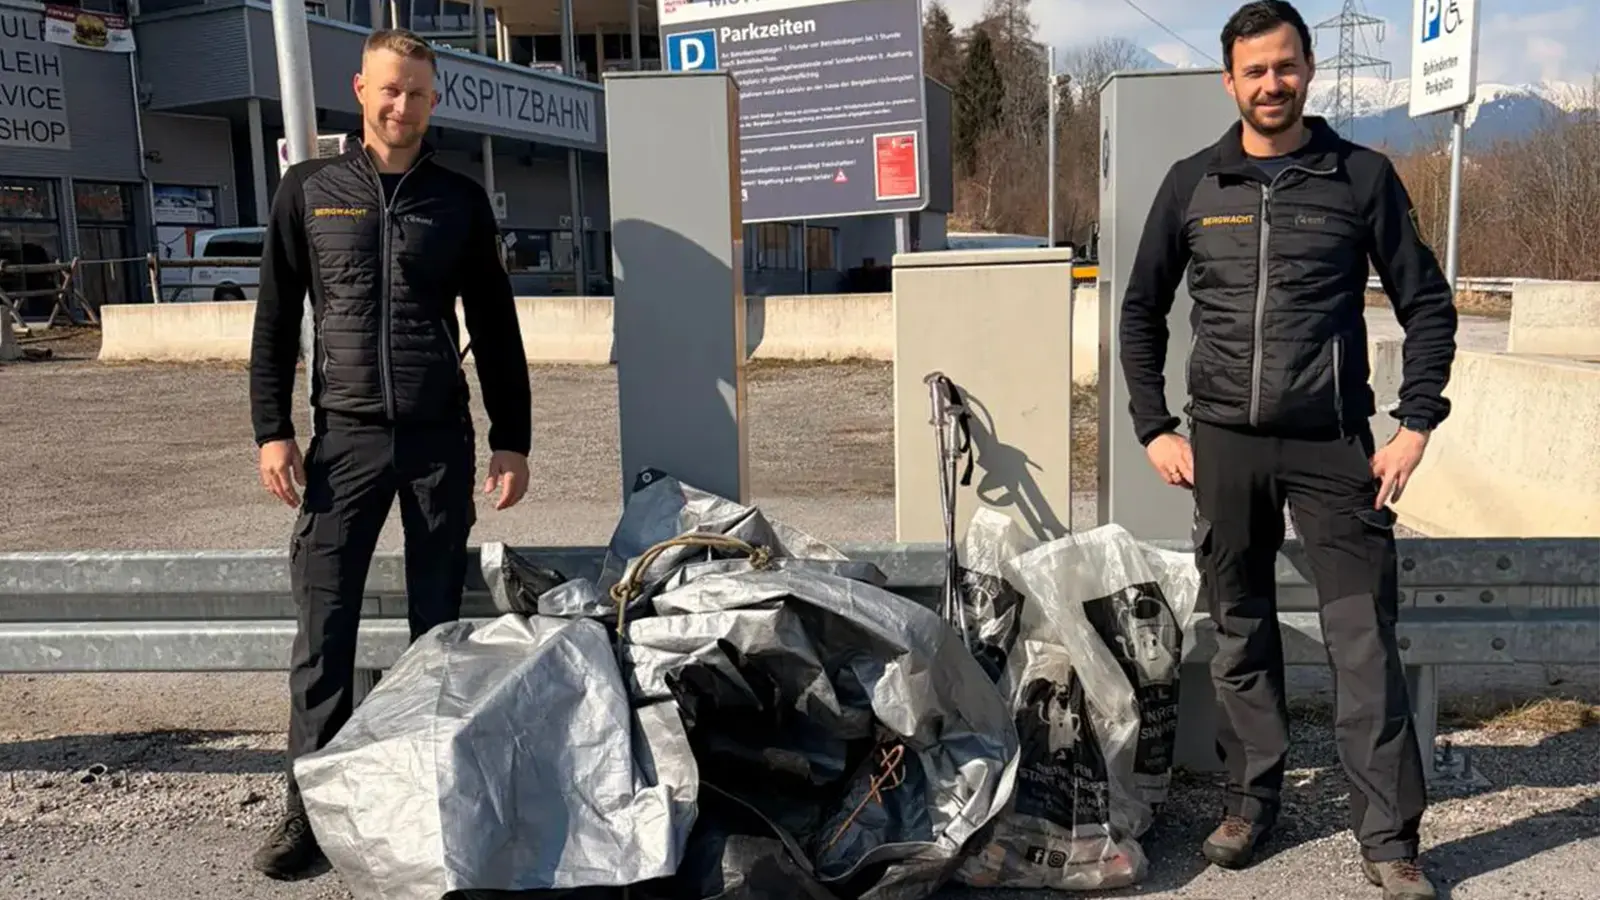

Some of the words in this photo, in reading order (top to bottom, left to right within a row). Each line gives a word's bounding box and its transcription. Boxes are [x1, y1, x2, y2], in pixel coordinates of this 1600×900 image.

[720, 18, 816, 44] Parkzeiten
[1, 49, 60, 77] LEIH
[0, 84, 62, 110] VICE
[1426, 76, 1454, 96] Parkplatz
[436, 70, 590, 133] KSPITZBAHN
[0, 117, 65, 143] SHOP
[313, 207, 368, 217] BERGWACHT
[1202, 214, 1254, 226] BERGWACHT
